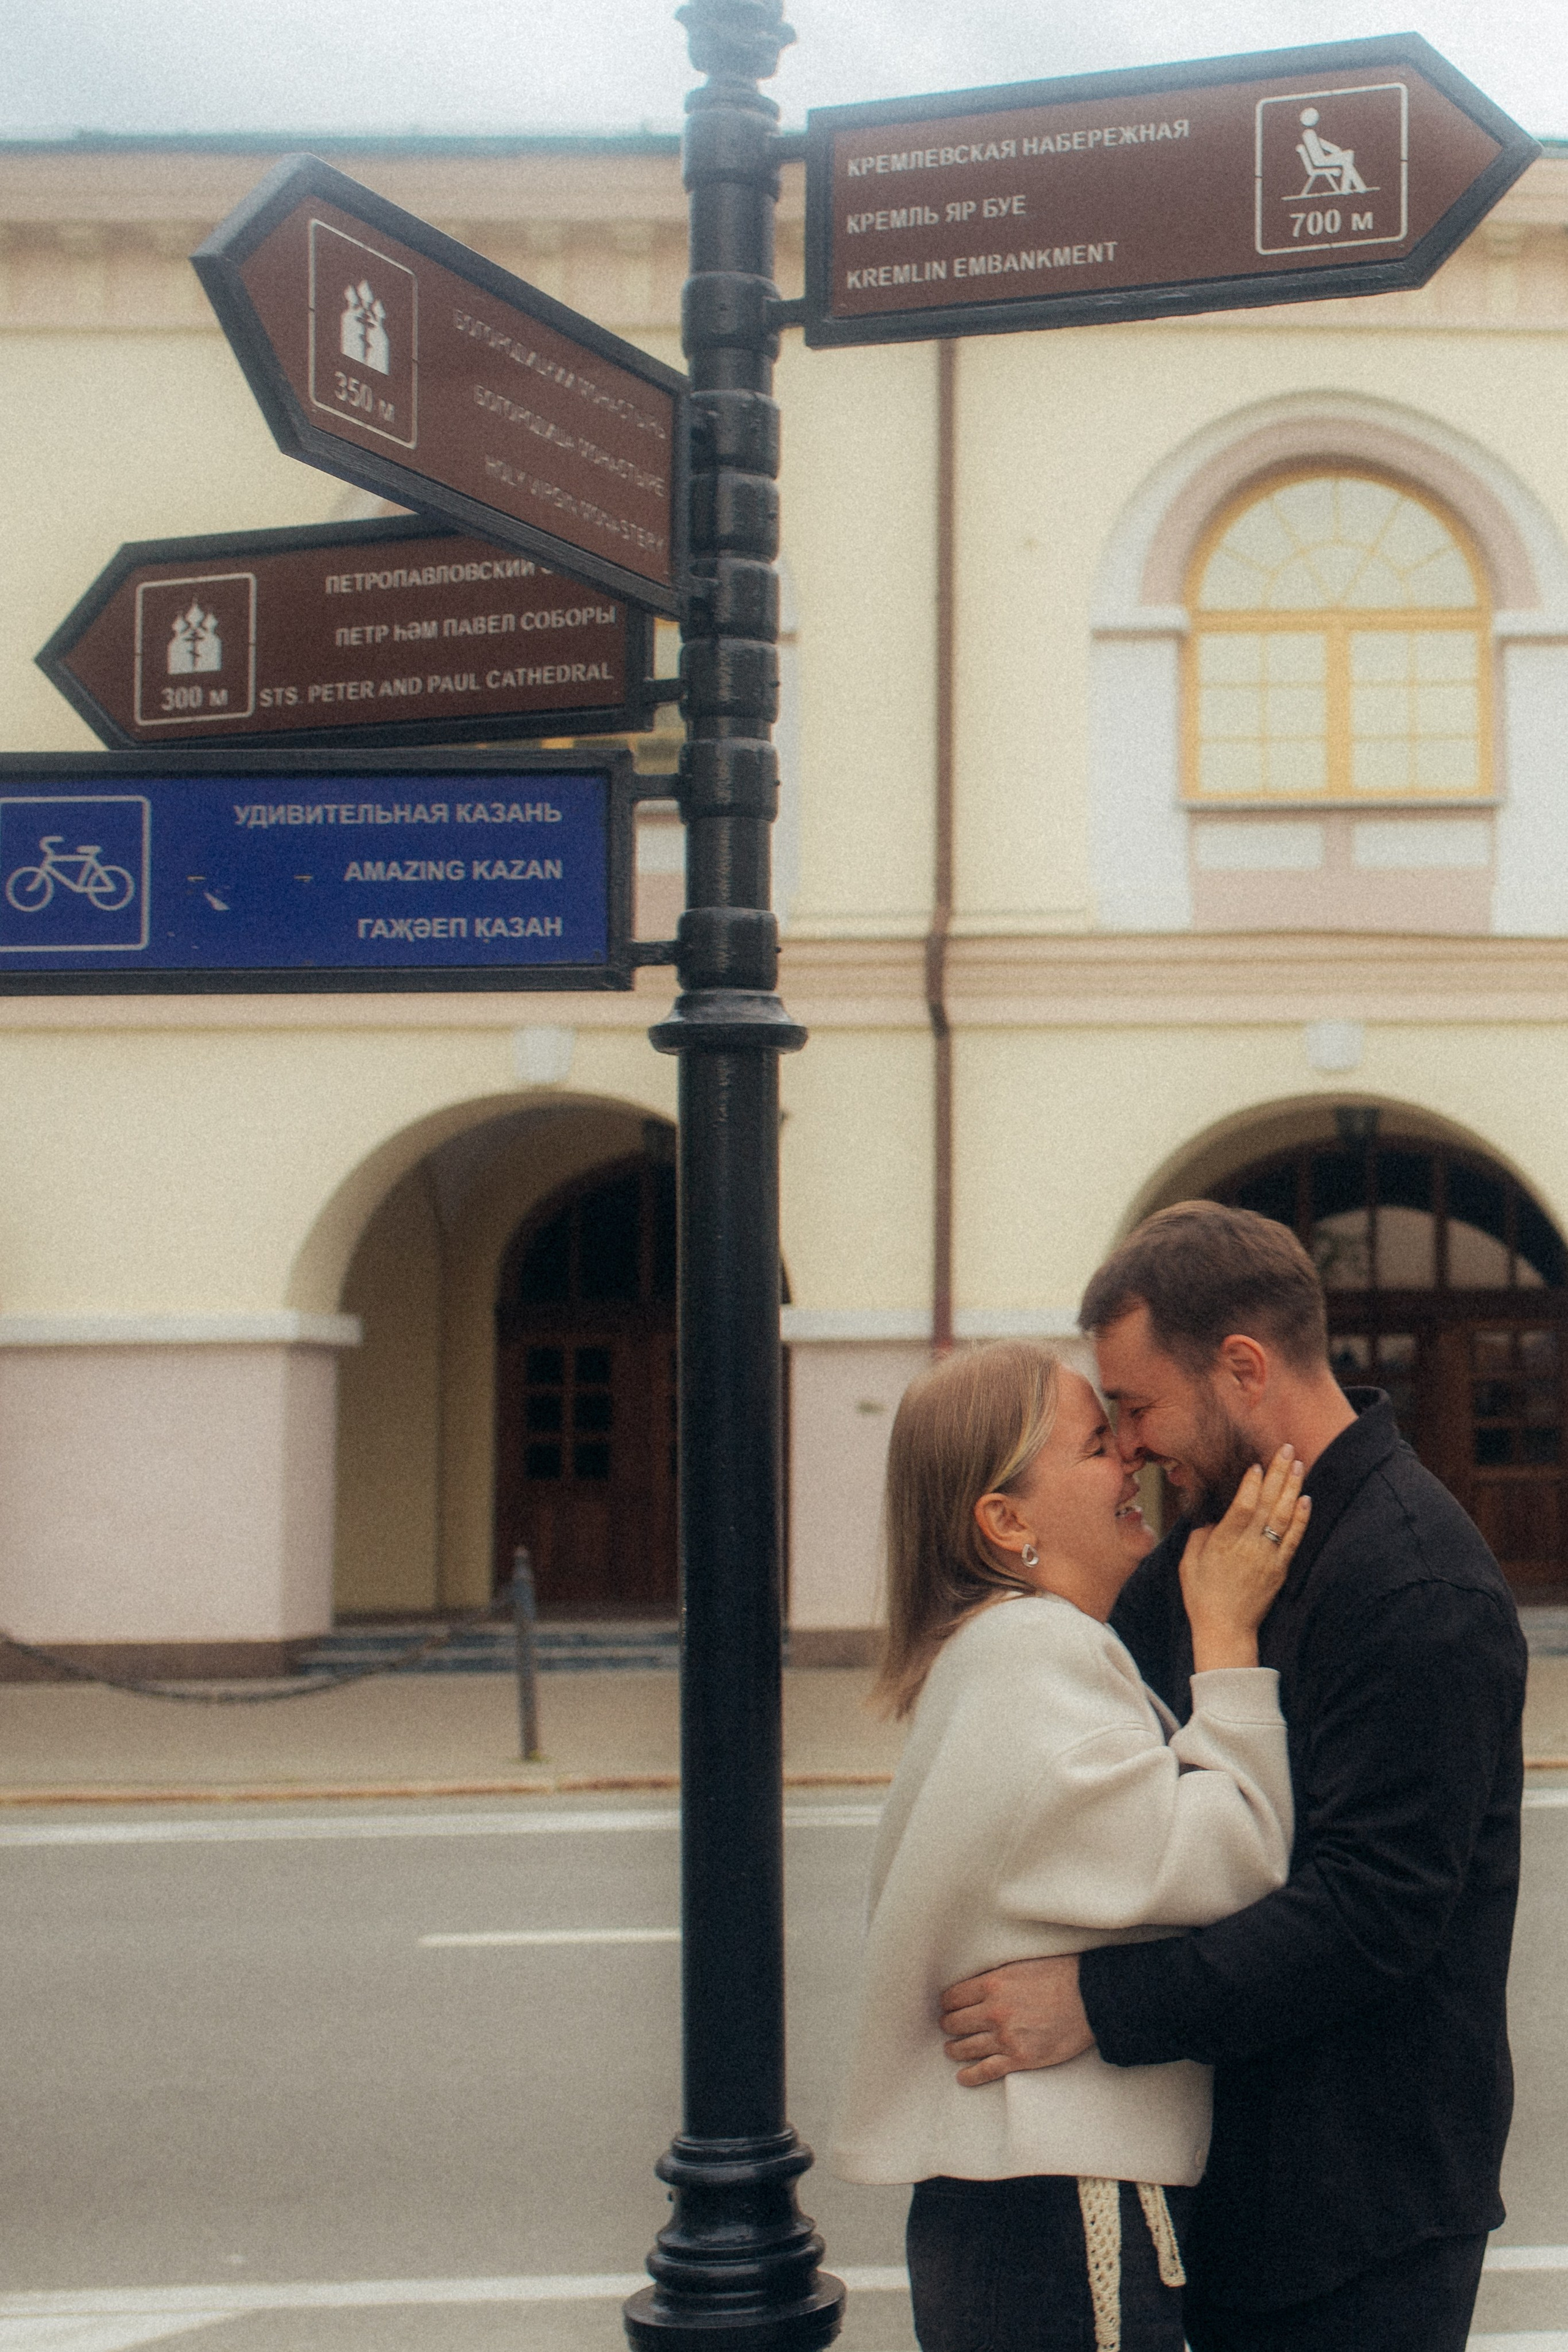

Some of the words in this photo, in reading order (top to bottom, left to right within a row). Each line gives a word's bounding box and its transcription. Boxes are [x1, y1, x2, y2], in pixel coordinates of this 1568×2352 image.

[848, 139, 1016, 176] КРЕМЛЕВСКАЯ
[1022, 118, 1189, 155] НАБЕРЕЖНАЯ
[846, 206, 939, 234] КРЕМЛЬ
[945, 200, 976, 222] ЯР
[982, 194, 1026, 218] БУЕ
[1290, 209, 1341, 237] 700
[846, 260, 946, 289] KREMLIN
[954, 241, 1117, 277] EMBANKMENT
[335, 371, 372, 412] 350
[335, 624, 390, 646] ПЕТР
[443, 613, 515, 637] ПАВЕЛ
[520, 606, 615, 631] СОБОРЫ
[161, 685, 203, 711] 300
[308, 680, 374, 703] PETER
[379, 677, 423, 696] AND
[427, 673, 480, 693] PAUL
[486, 662, 613, 689] CATHEDRAL
[233, 803, 449, 828] УДИВИТЕЛЬНАЯ
[456, 802, 562, 823] КАЗАНЬ
[344, 860, 466, 881] AMAZING
[472, 859, 562, 880] KAZAN
[475, 917, 562, 938] КАЗАН
